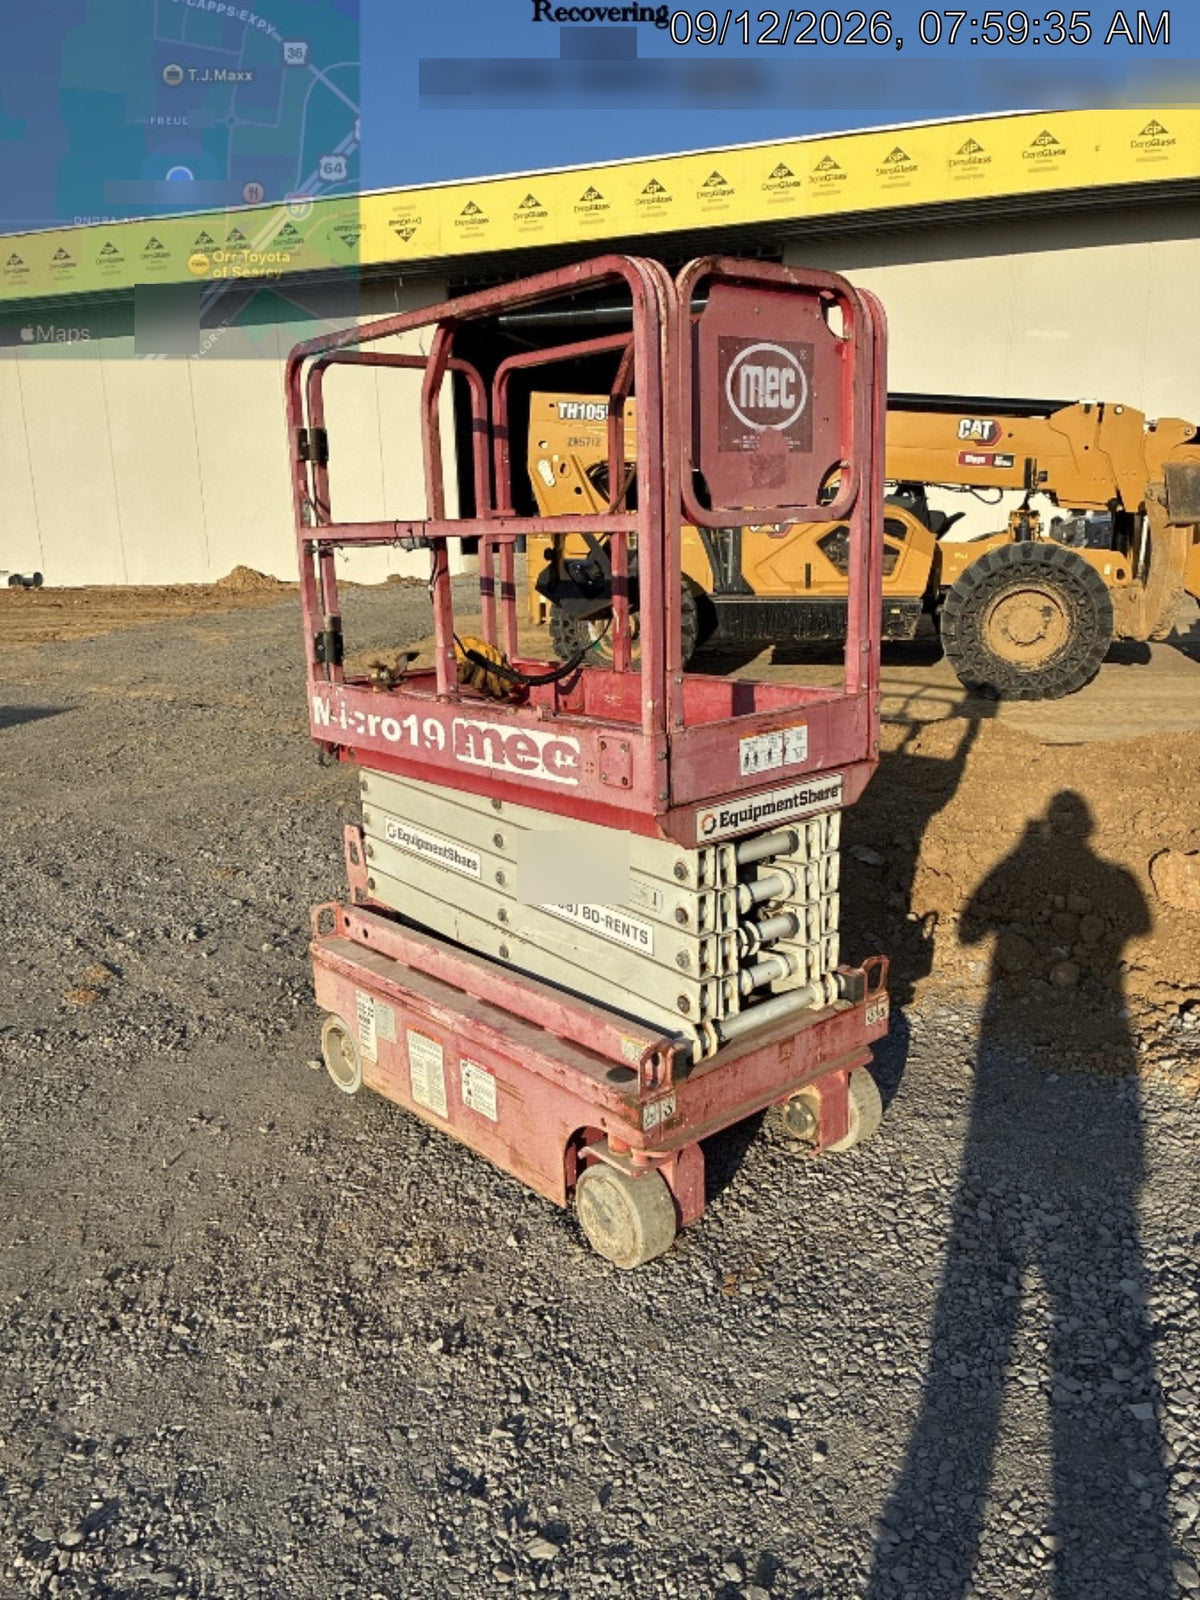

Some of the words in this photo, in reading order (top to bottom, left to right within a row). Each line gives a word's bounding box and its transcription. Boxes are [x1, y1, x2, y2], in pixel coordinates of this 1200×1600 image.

[740, 364, 796, 410] mec
[558, 402, 609, 420] TH105
[957, 418, 994, 440] CAT
[719, 786, 840, 829] EquipmentShare
[397, 827, 478, 871] EquipmentShare
